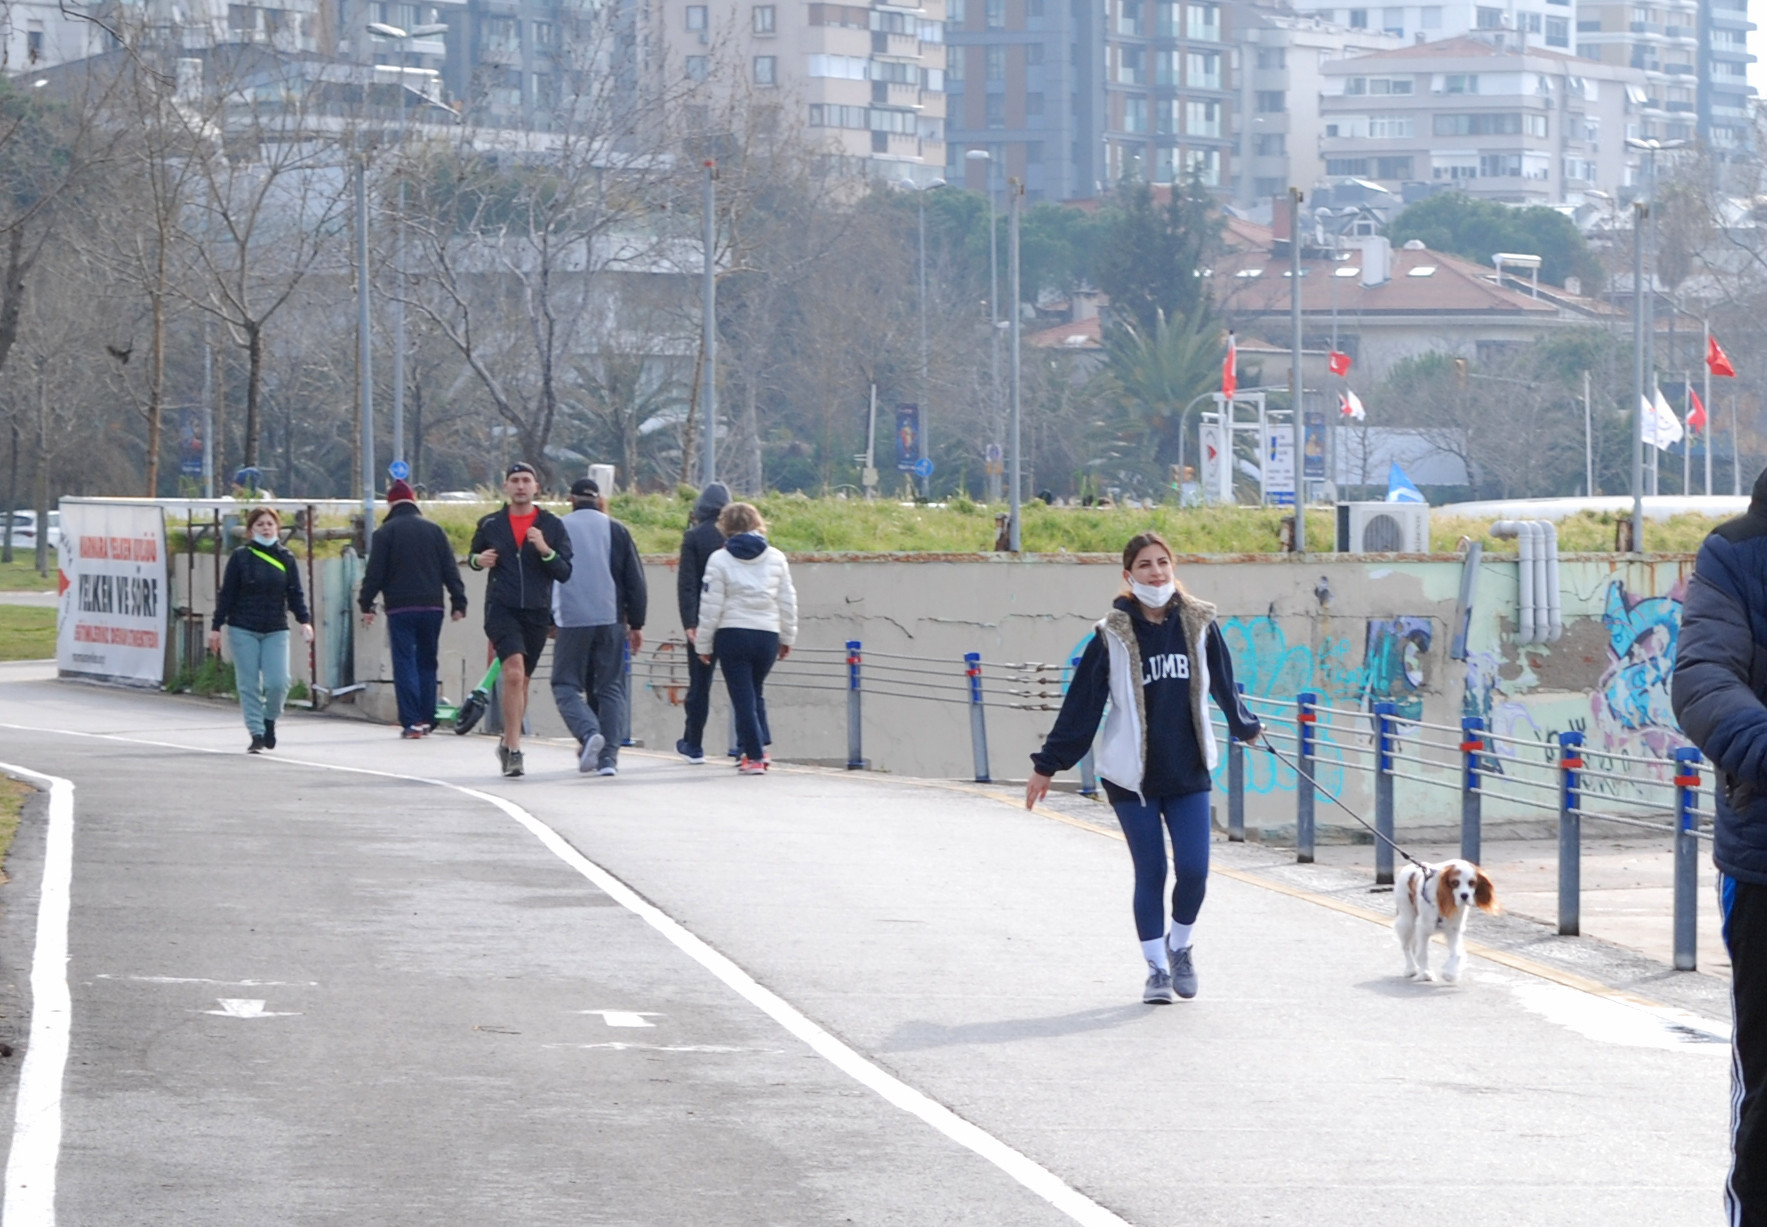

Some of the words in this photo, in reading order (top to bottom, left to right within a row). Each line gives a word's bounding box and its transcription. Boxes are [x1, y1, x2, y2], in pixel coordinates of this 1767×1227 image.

[78, 574, 113, 613] YELKEN
[116, 576, 129, 615] VE
[131, 566, 158, 617] SÖRF
